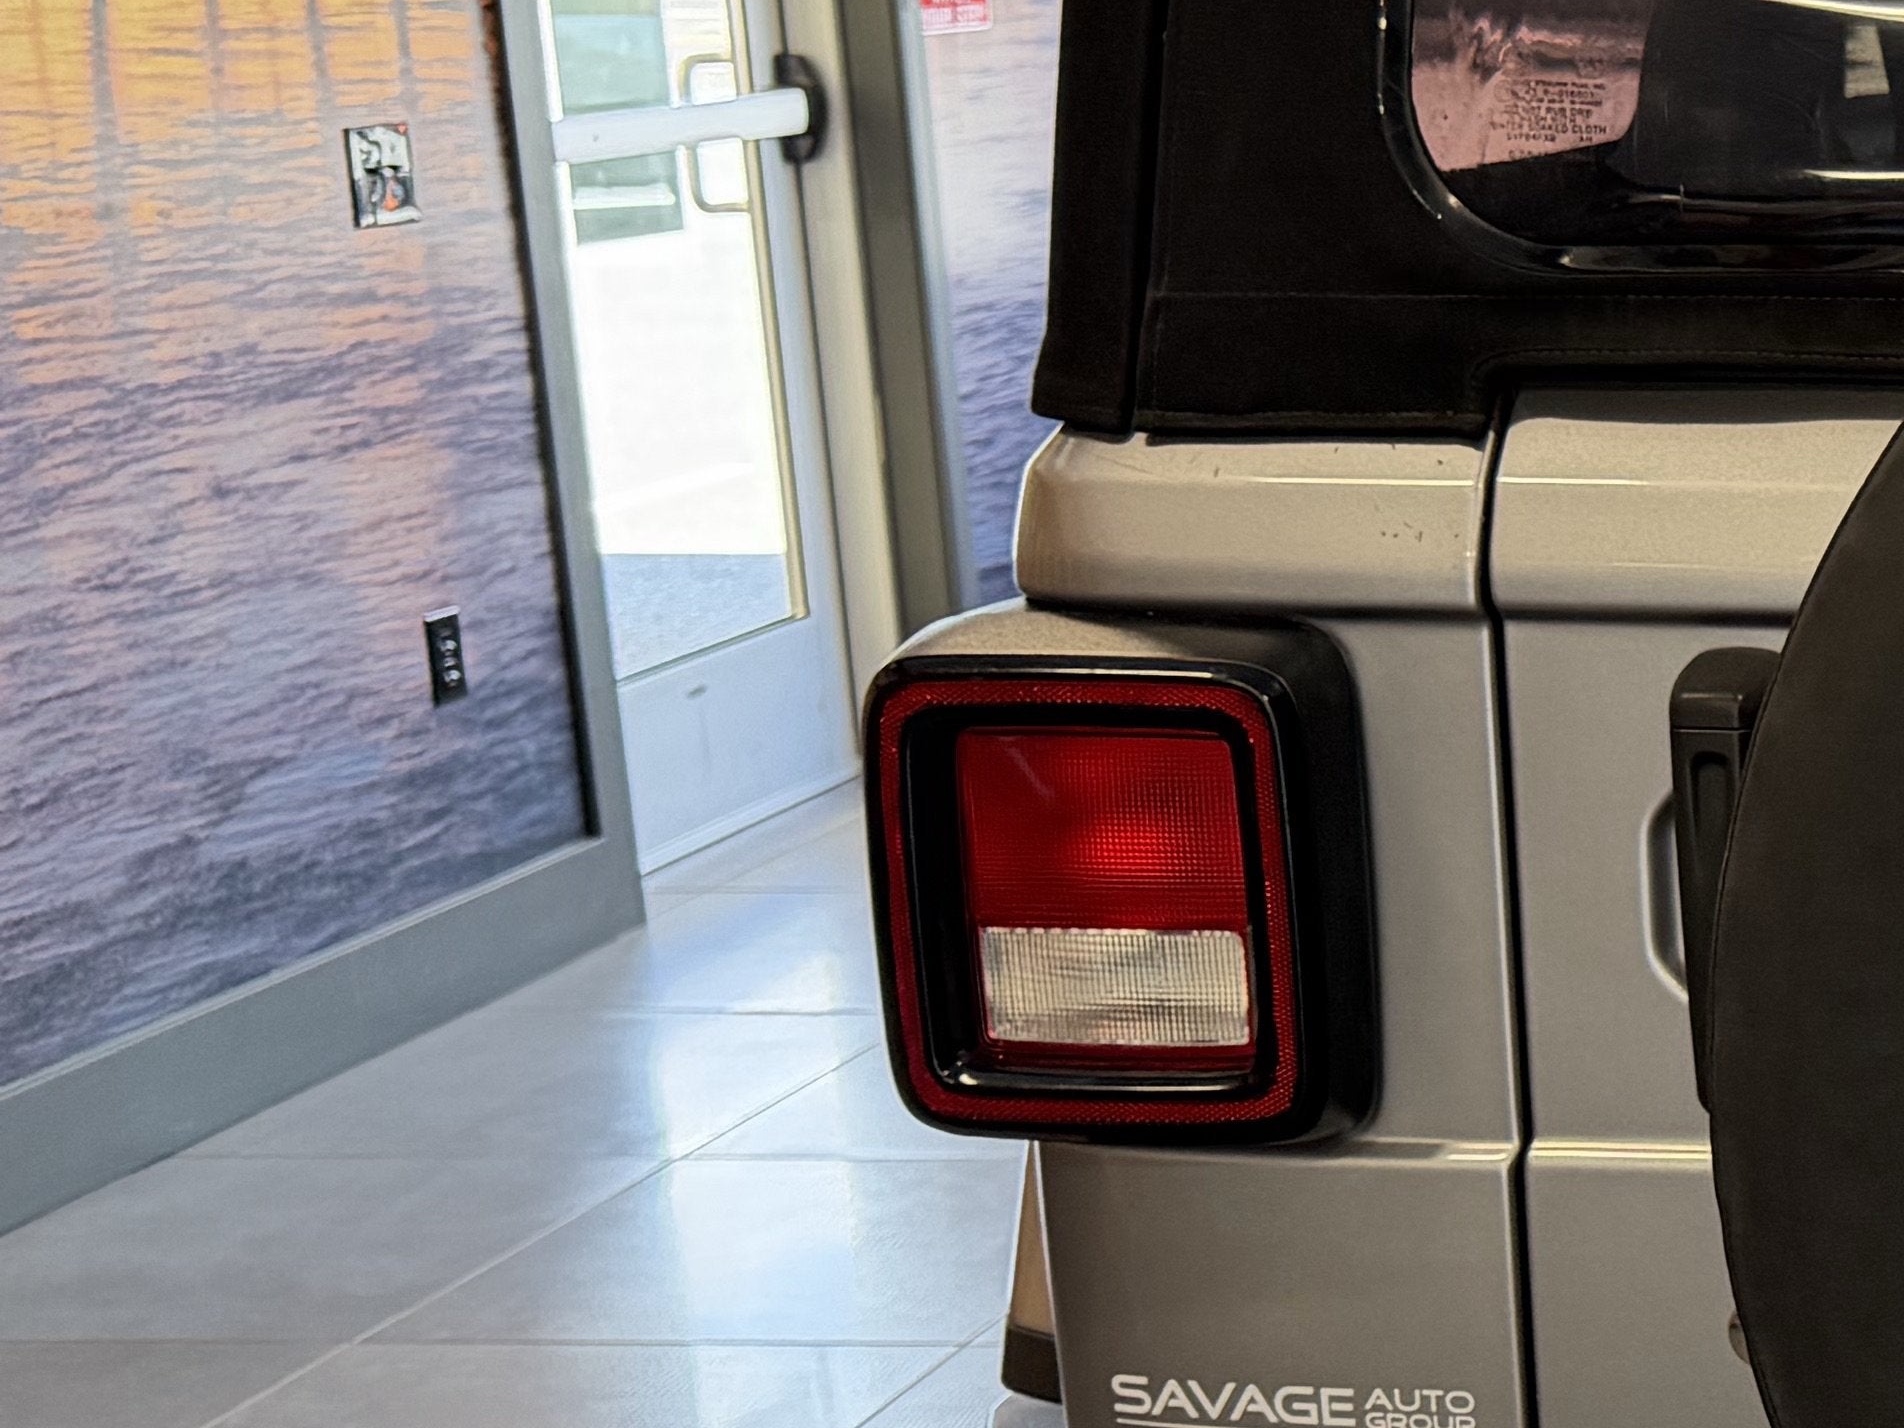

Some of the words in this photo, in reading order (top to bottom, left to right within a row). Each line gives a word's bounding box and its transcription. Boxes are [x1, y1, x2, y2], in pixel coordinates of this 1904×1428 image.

[1571, 125, 1607, 134] CLOTH
[1111, 1374, 1356, 1427] SAVAGE
[1365, 1388, 1475, 1414] AUTO
